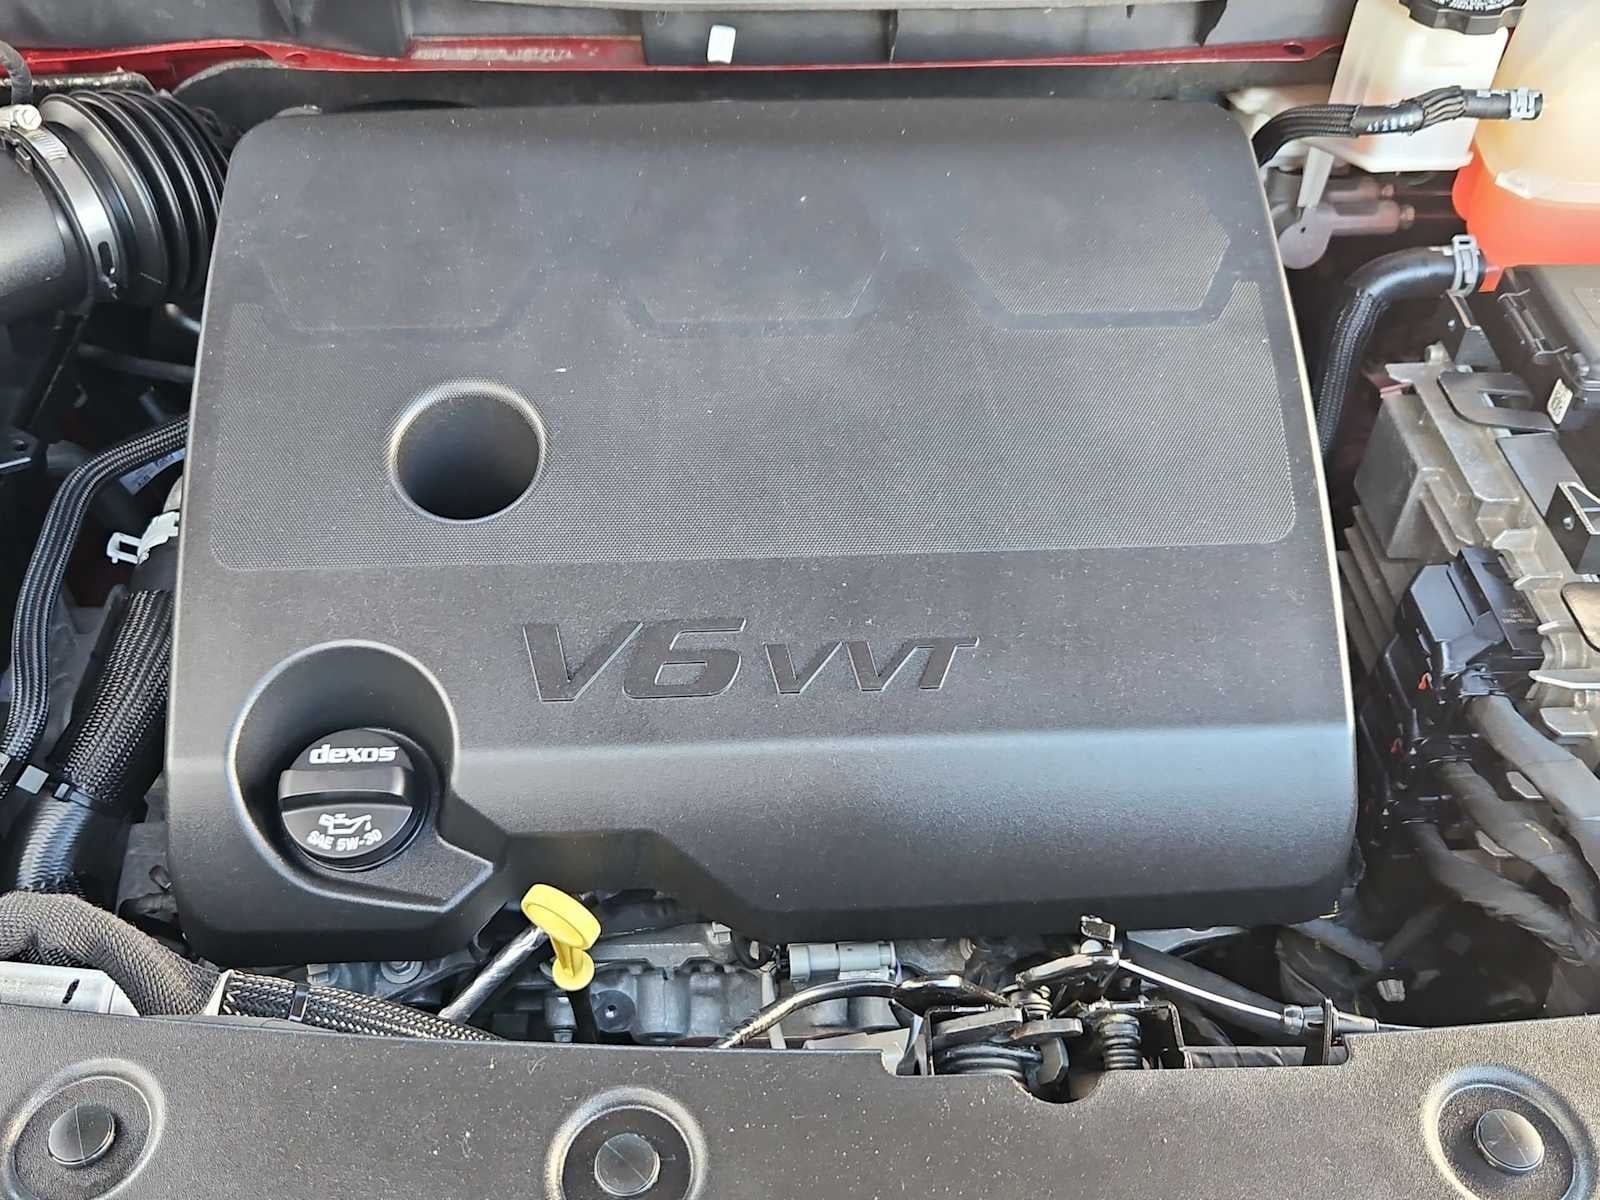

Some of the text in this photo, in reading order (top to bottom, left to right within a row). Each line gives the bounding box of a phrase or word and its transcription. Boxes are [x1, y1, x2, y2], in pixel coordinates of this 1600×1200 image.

[522, 616, 980, 702] V6 VVT
[309, 744, 400, 764] dexos
[306, 828, 383, 852] SAE 5W-30
